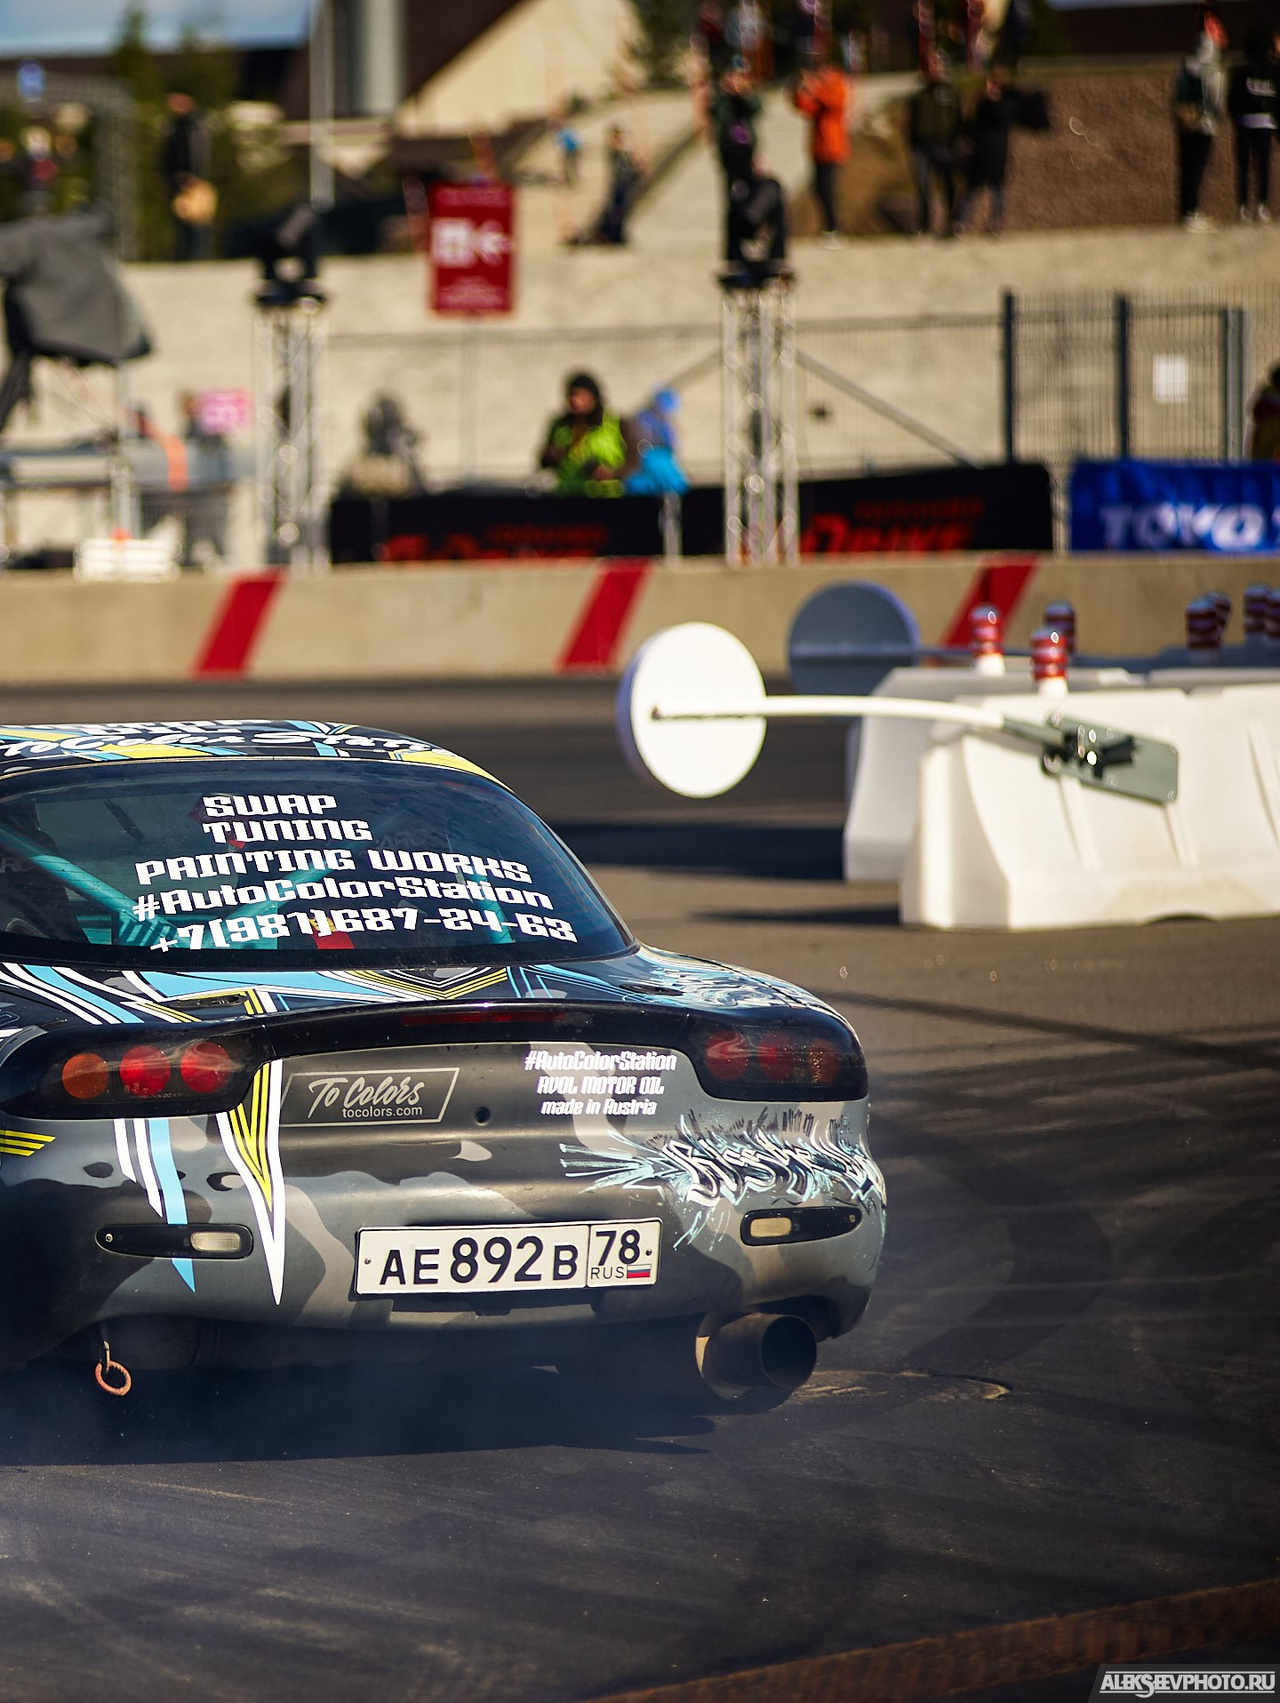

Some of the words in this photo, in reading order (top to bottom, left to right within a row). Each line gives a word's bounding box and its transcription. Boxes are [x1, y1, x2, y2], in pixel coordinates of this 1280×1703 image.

[202, 794, 337, 817] SWAP
[202, 820, 373, 843] TUNING
[135, 849, 356, 886] PAINTING
[368, 850, 532, 884] WORKS
[132, 877, 553, 922] #AutoColorStation
[525, 1050, 677, 1072] #AutoColorStation
[537, 1075, 578, 1095] AVOL
[581, 1075, 637, 1095] MOTOR
[639, 1075, 665, 1095] OIL
[308, 1077, 348, 1119] To
[343, 1076, 425, 1109] Colors
[541, 1099, 582, 1116] made
[586, 1099, 600, 1116] in
[603, 1098, 657, 1116] Austria
[342, 1106, 423, 1119] tocolors.com
[595, 1229, 641, 1267] 78
[591, 1266, 625, 1280] RUS
